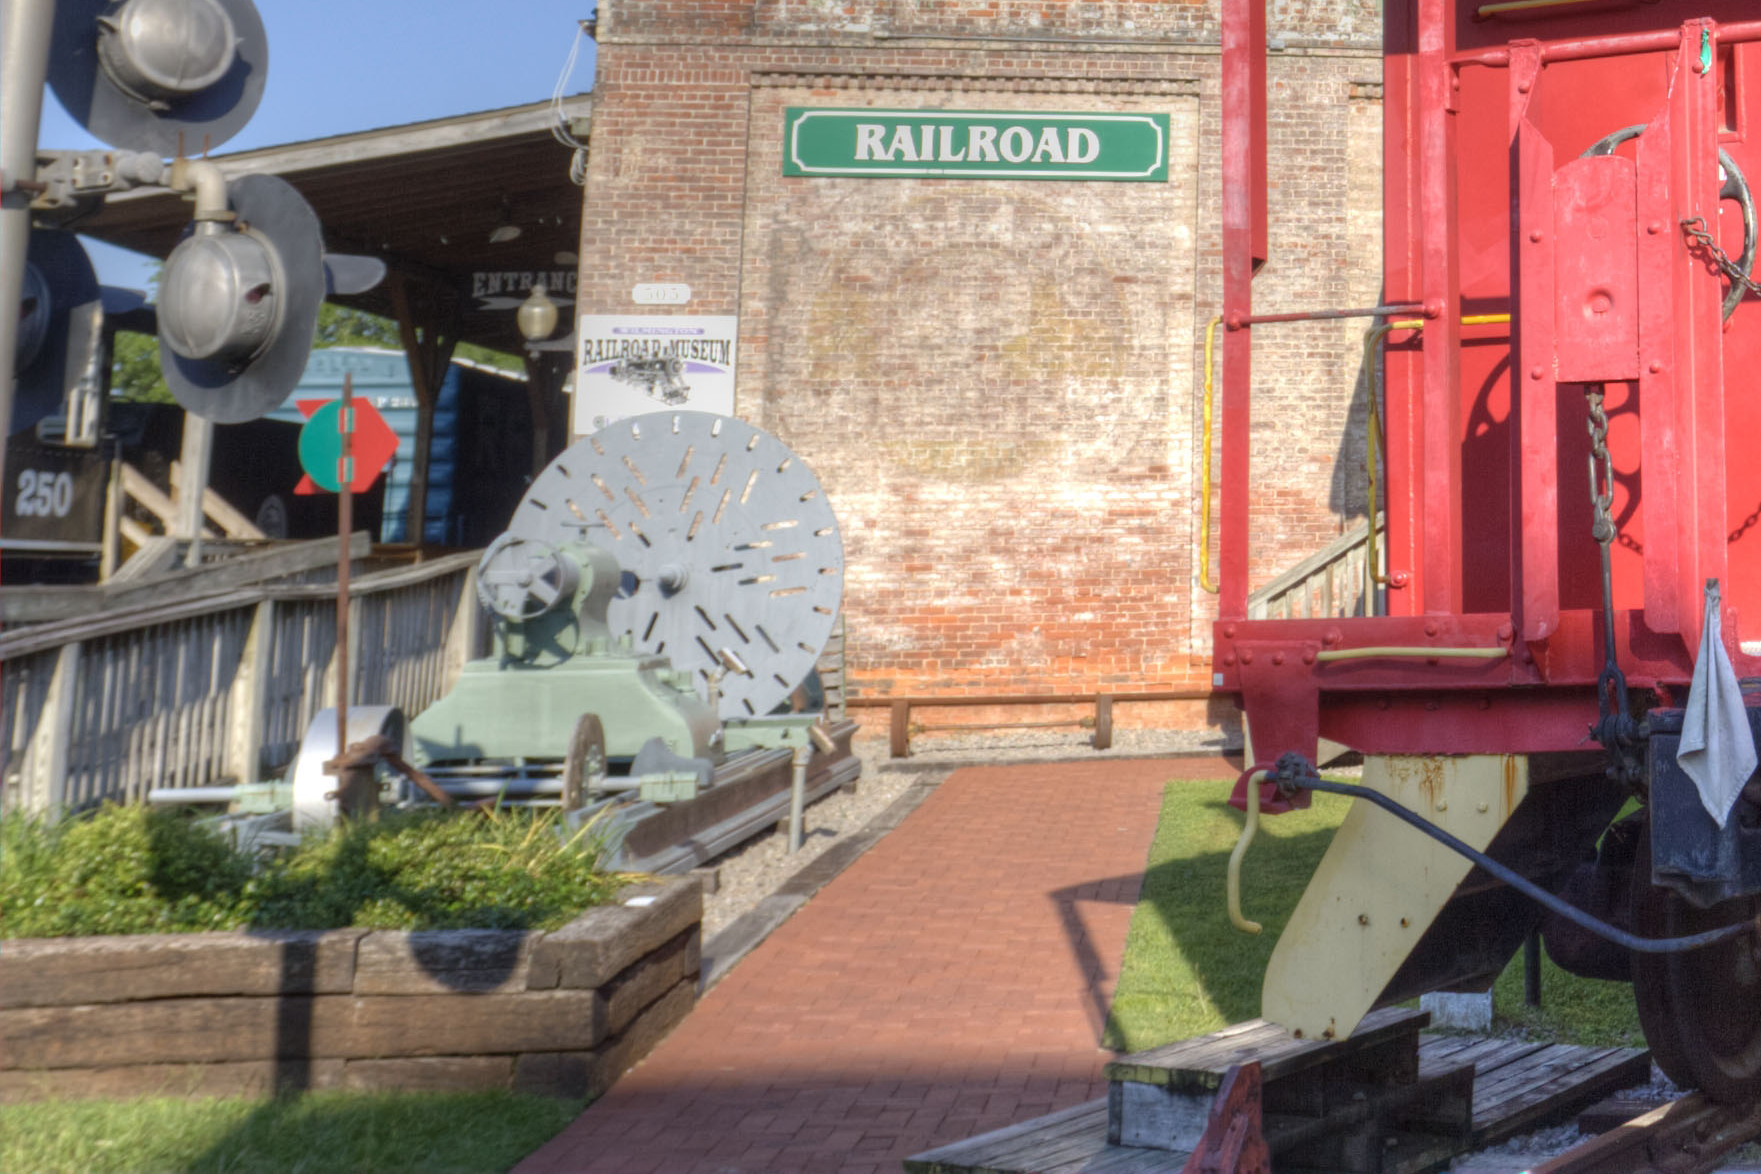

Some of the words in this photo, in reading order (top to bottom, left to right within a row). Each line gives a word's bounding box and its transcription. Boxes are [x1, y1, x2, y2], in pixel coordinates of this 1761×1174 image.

[854, 123, 1100, 163] RAILROAD
[472, 271, 577, 298] ENTRANC
[583, 338, 661, 366] RAILROAD
[669, 338, 731, 366] MUSEUM
[15, 468, 74, 518] 250
